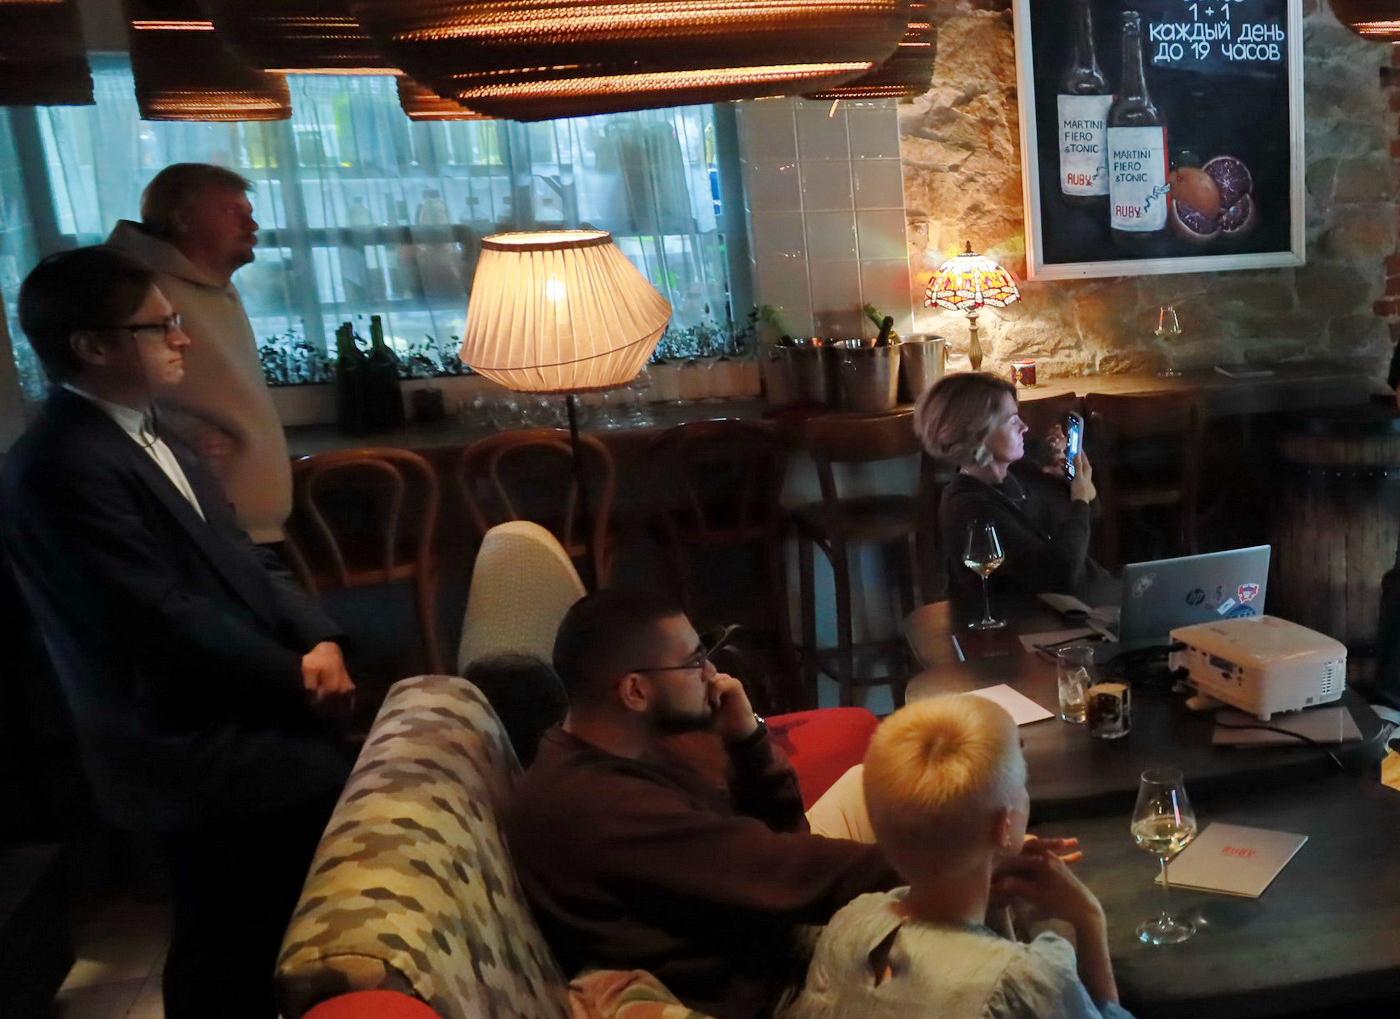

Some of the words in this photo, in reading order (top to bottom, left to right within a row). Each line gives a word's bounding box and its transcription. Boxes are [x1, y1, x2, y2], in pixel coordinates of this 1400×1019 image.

[1149, 21, 1231, 42] каждый
[1237, 23, 1285, 42] день
[1154, 42, 1184, 62] до
[1191, 42, 1210, 60] 19
[1221, 43, 1281, 60] часов
[1063, 120, 1103, 130] MARTINI
[1064, 132, 1093, 142] FIERO
[1113, 150, 1151, 159] MARTINI
[1113, 162, 1142, 171] FIERO
[1067, 173, 1093, 186] RUBY
[1115, 205, 1141, 218] RUBY
